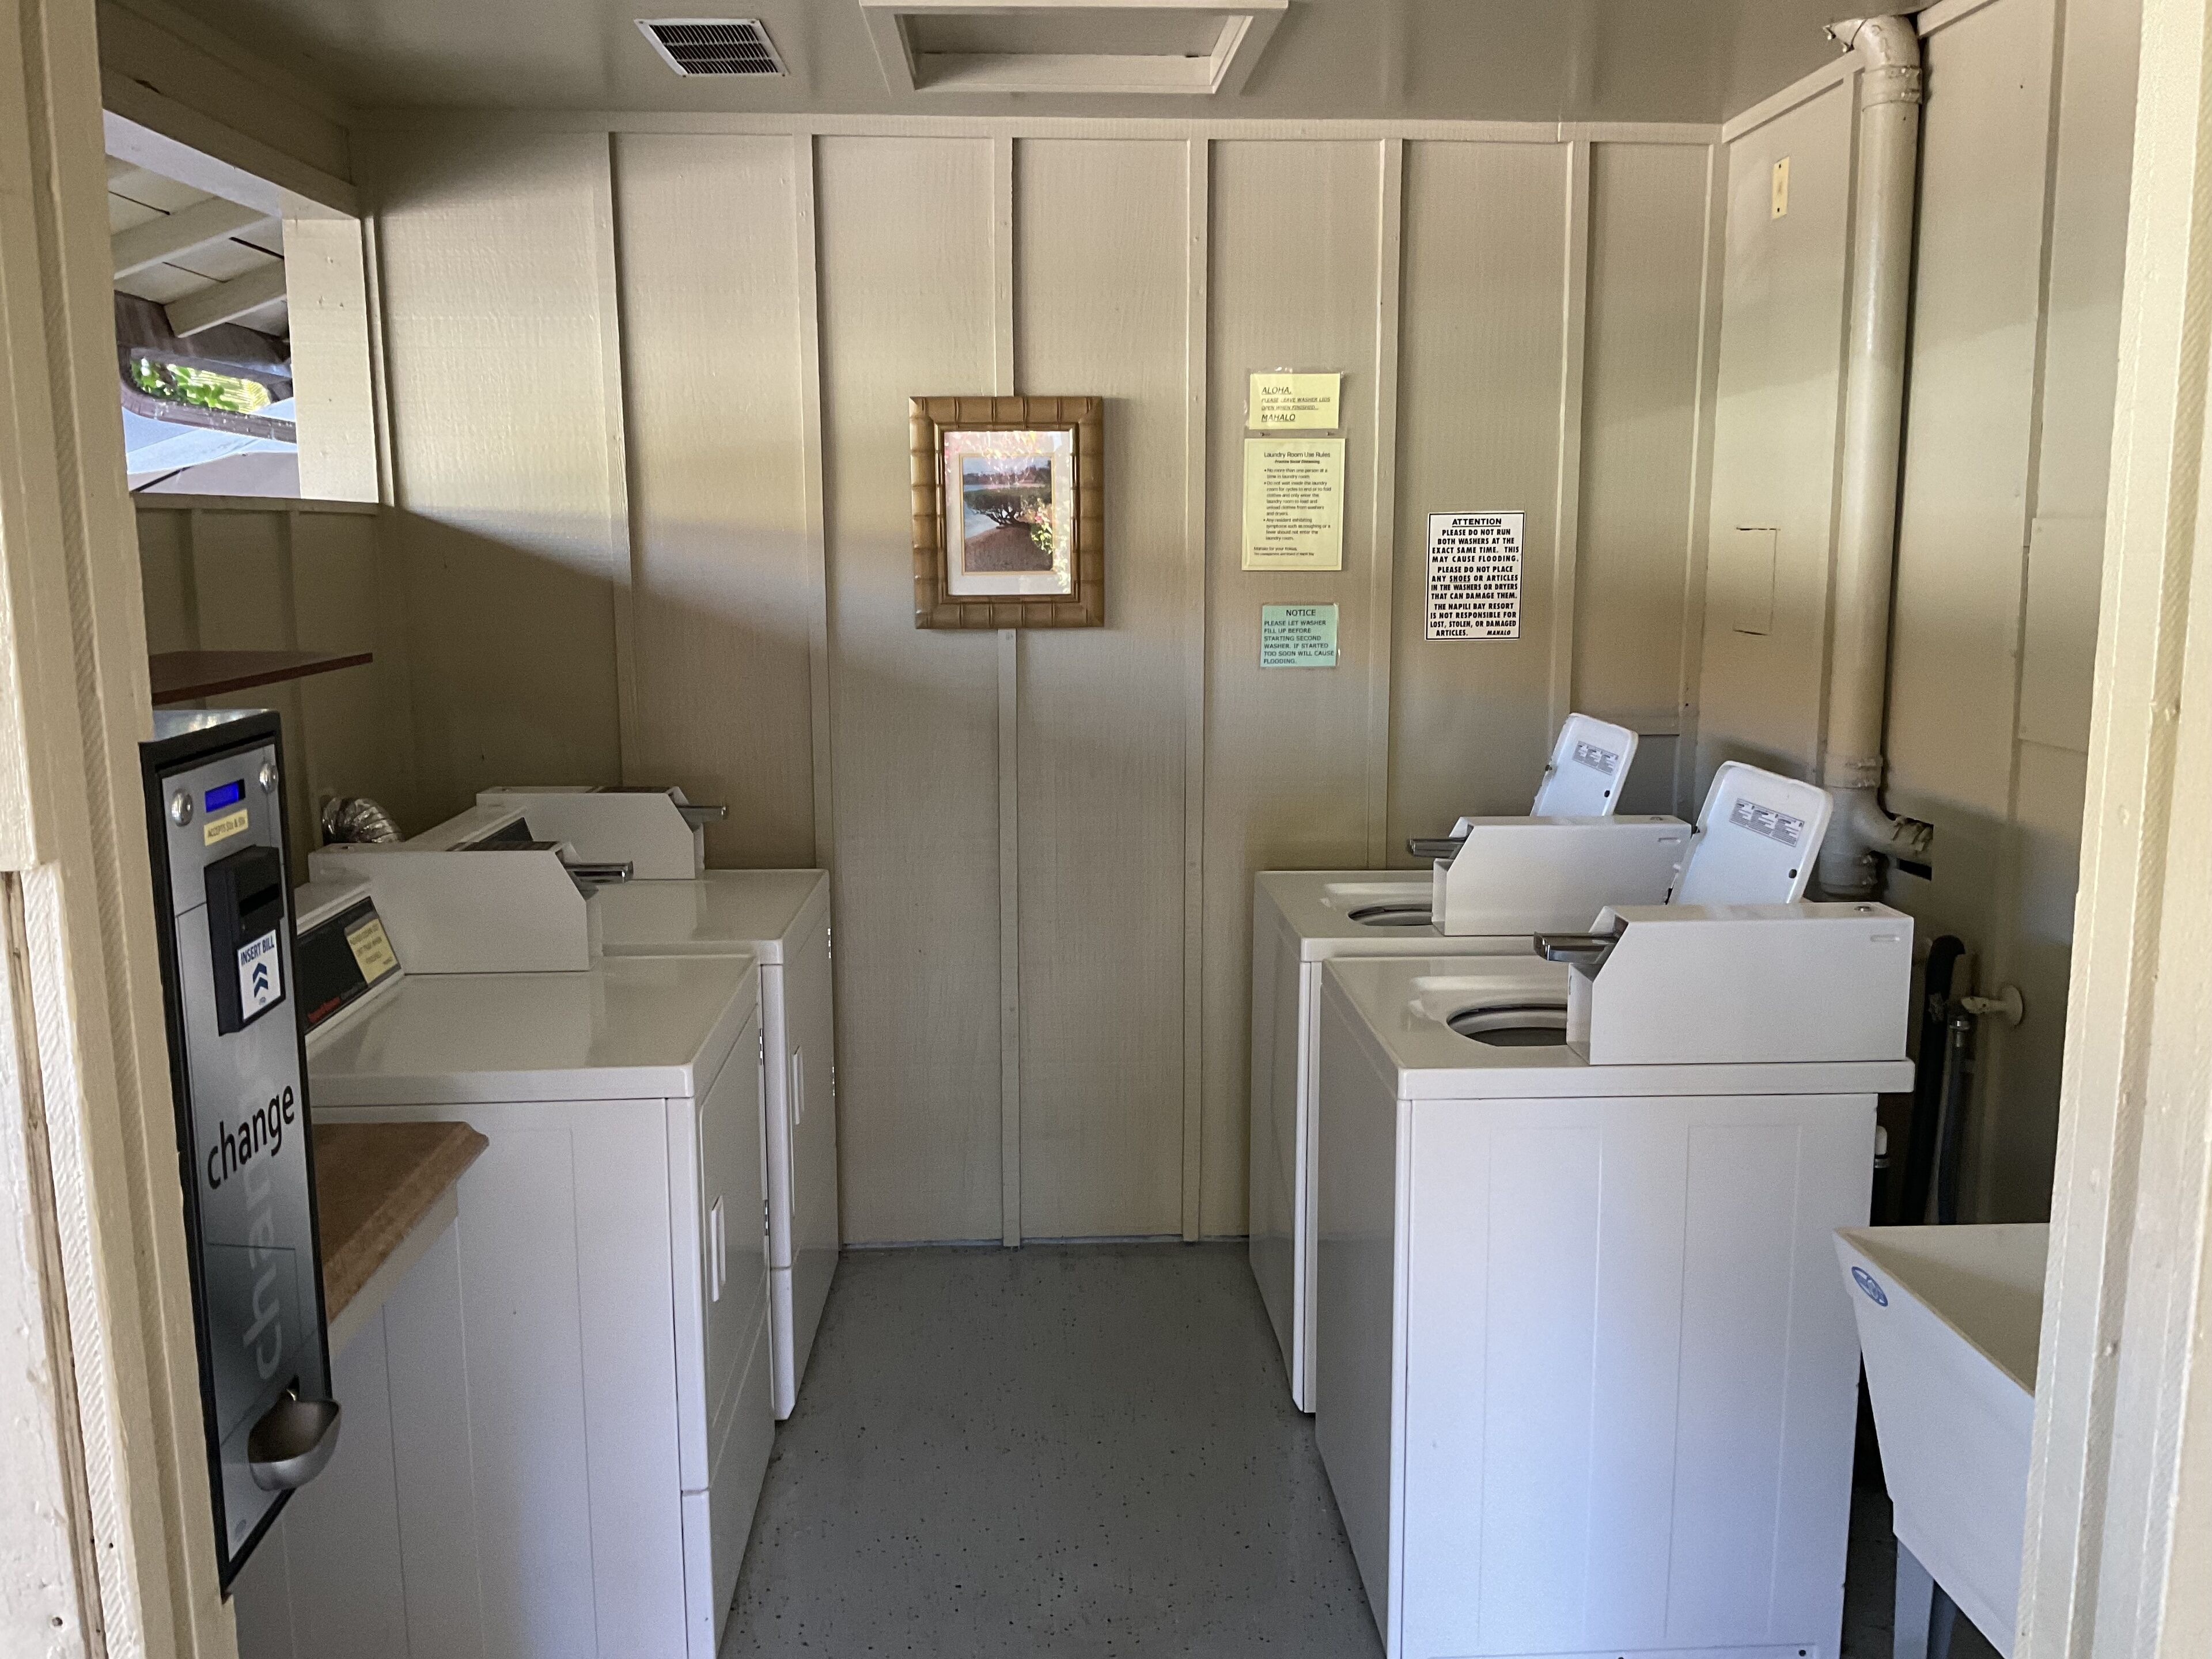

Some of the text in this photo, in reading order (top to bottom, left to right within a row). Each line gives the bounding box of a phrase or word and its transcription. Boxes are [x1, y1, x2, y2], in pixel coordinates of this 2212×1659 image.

[1261, 387, 1292, 395] ALOHA,
[240, 935, 275, 965] INSERT BILL
[207, 1085, 295, 1190] change
